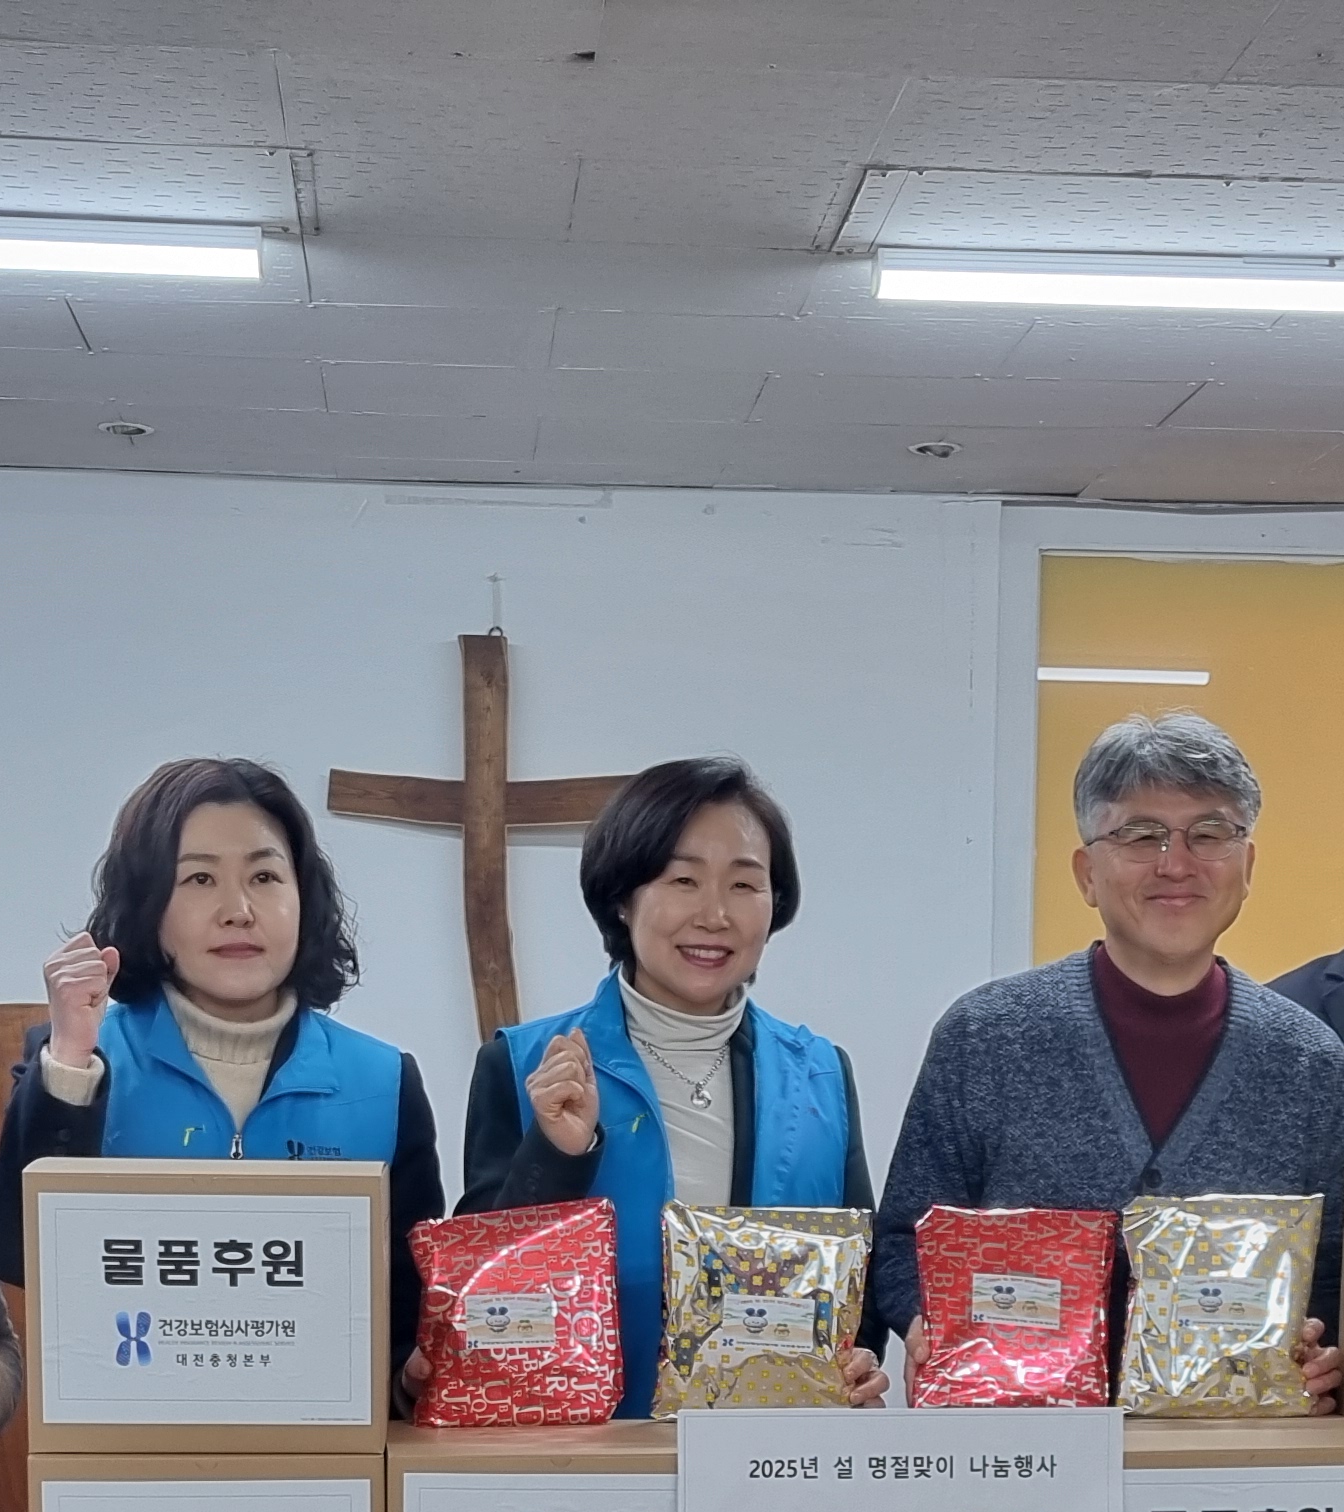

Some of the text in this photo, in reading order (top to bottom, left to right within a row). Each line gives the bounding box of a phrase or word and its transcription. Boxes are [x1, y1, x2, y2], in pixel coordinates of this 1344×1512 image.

[101, 1238, 304, 1288] 물품후원
[158, 1319, 296, 1338] 건강보험심사평가원
[176, 1353, 271, 1368] 대전충청본부
[749, 1454, 1057, 1480] 2025년 설 명절맞이 나눔행사
